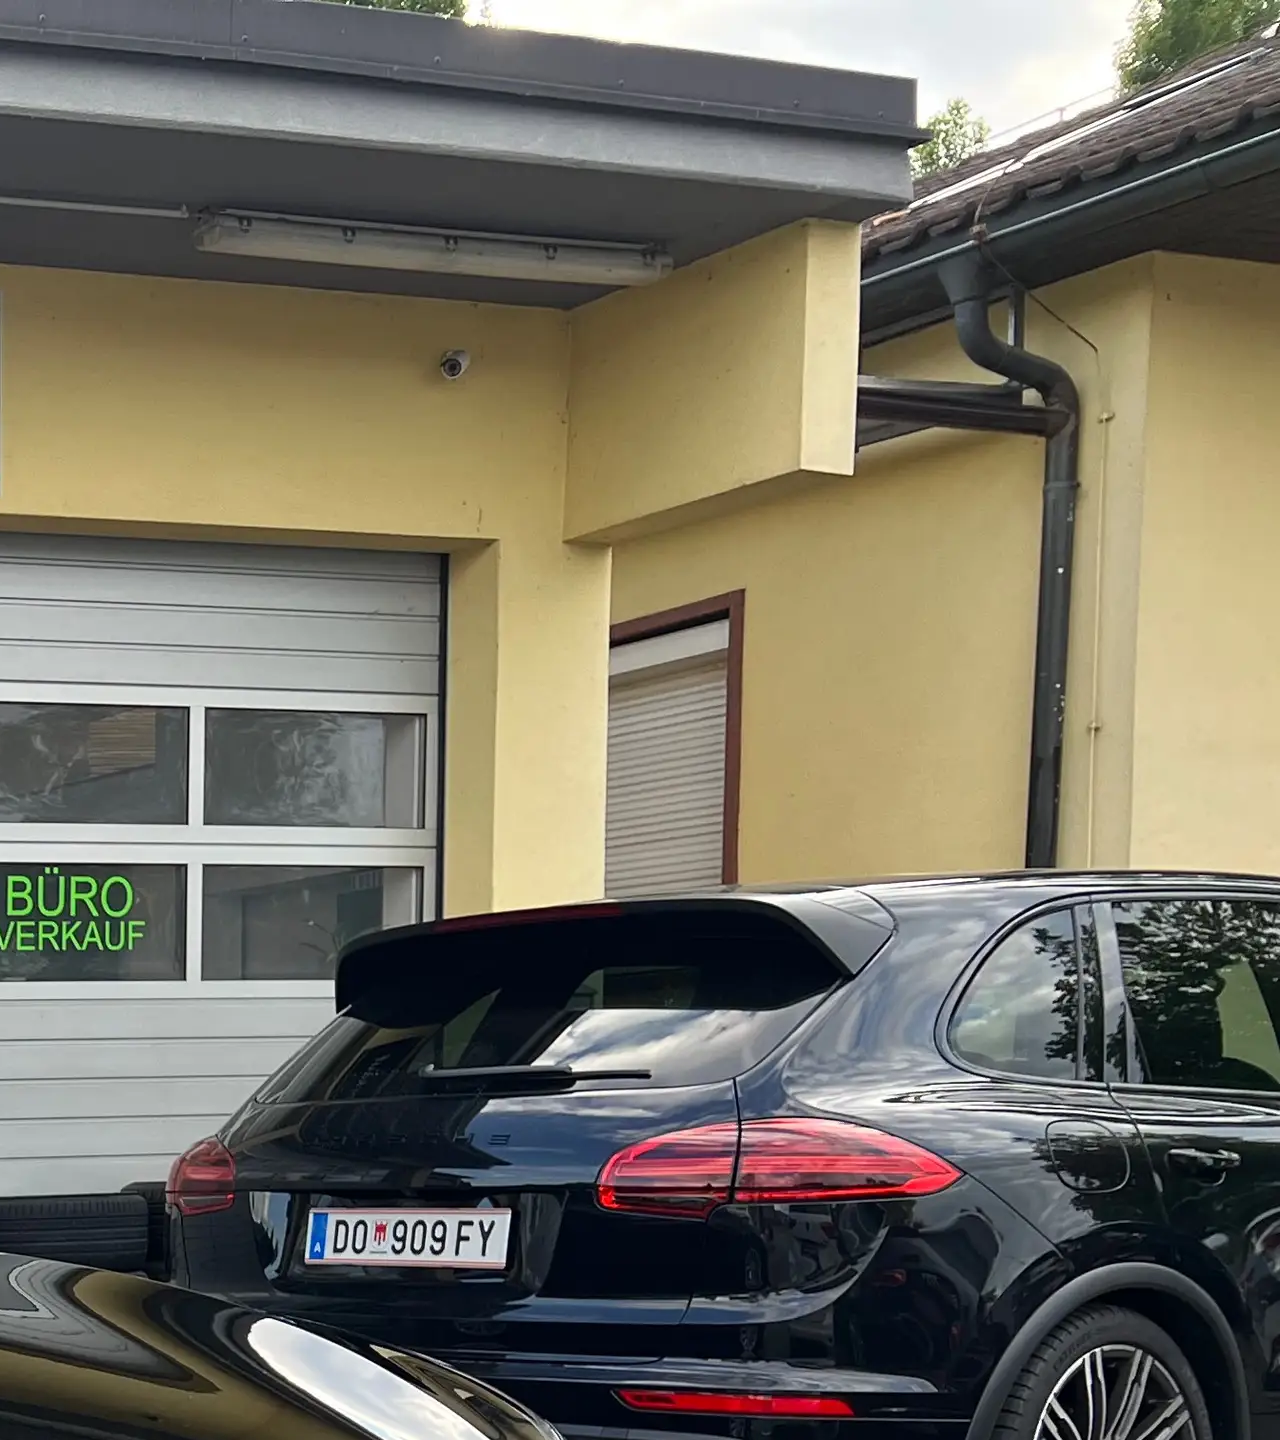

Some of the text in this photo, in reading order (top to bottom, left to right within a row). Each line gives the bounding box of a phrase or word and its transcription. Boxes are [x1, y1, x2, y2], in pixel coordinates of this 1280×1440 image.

[6, 868, 134, 919] BÜRO
[313, 1242, 321, 1253] A
[332, 1219, 369, 1255] DO
